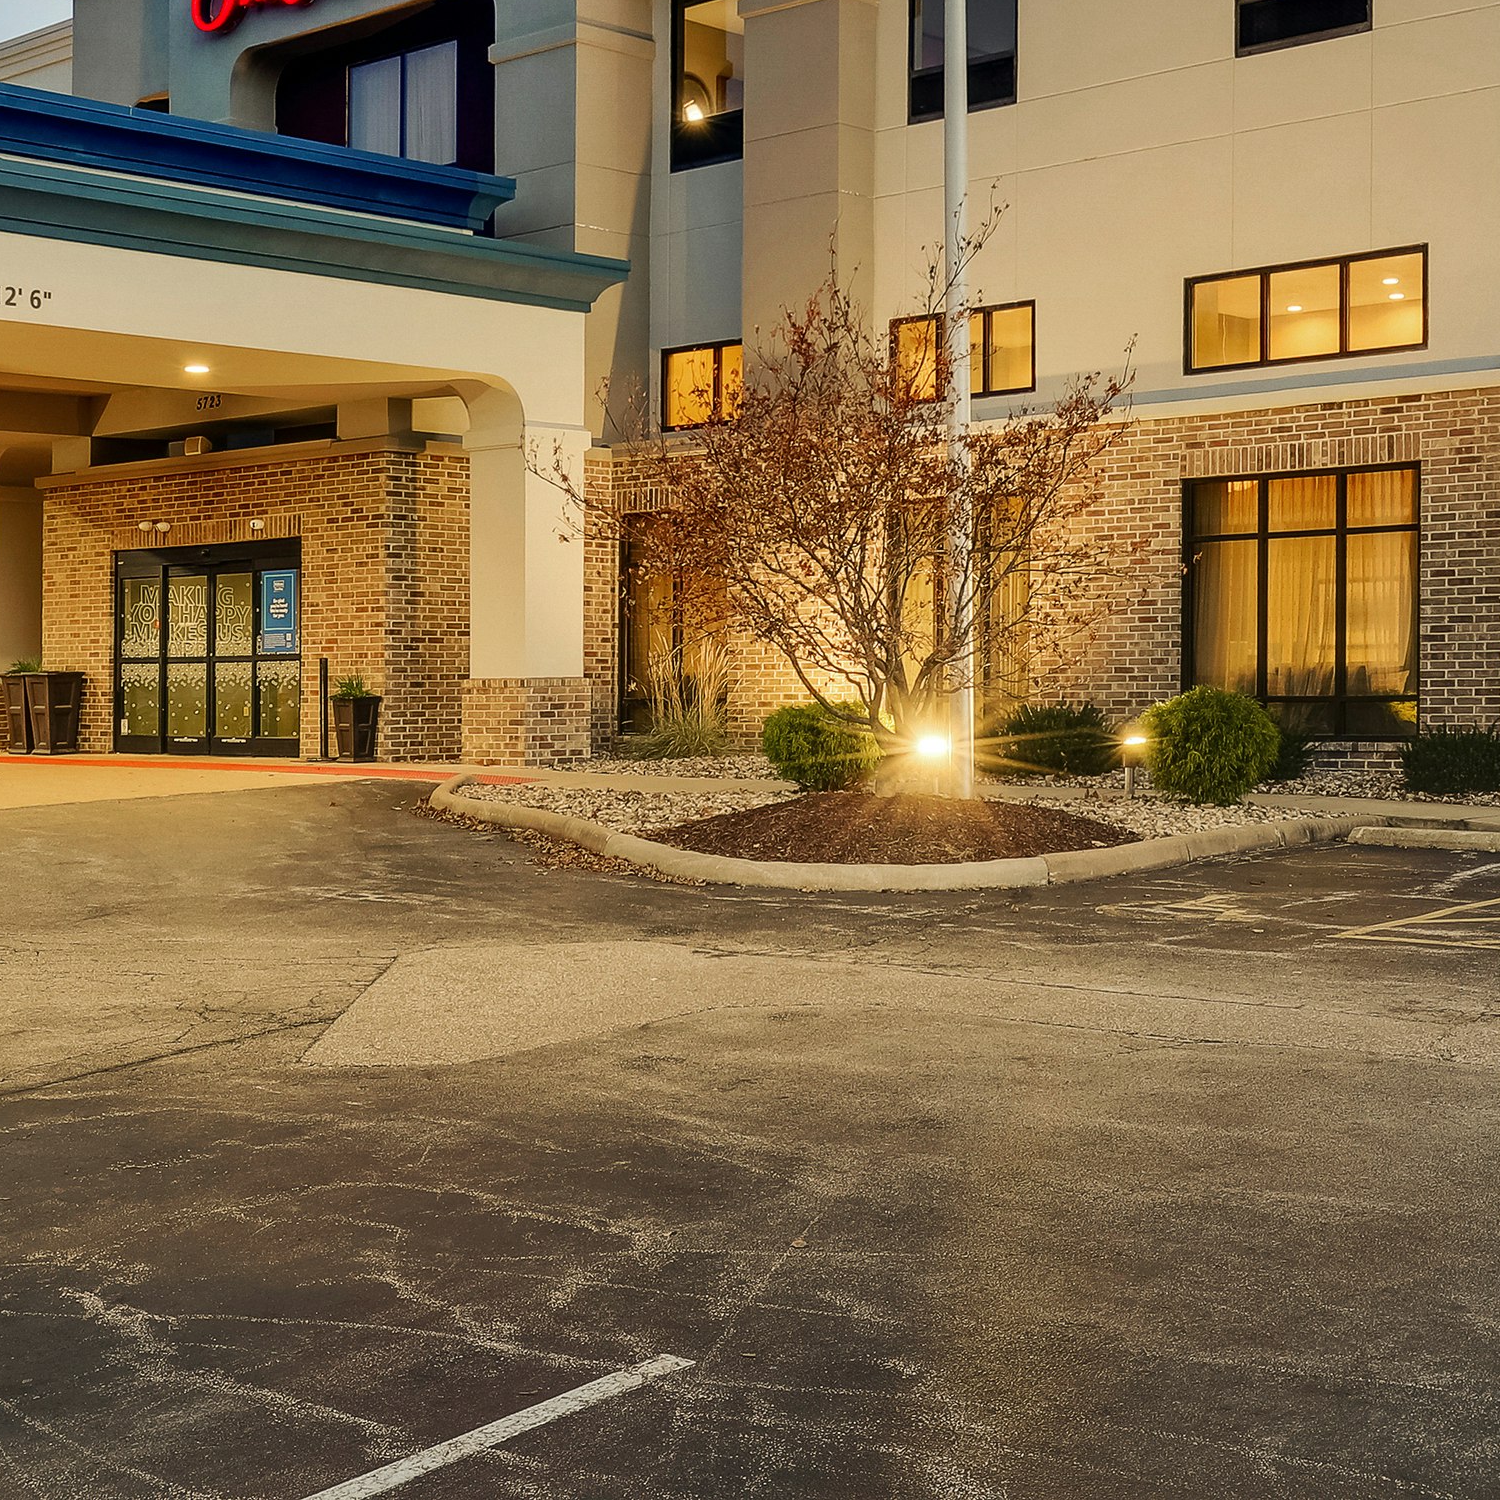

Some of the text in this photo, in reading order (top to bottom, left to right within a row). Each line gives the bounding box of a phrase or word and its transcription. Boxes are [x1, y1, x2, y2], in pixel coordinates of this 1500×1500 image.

[29, 289, 52, 310] 6"
[196, 394, 221, 411] 5723
[140, 584, 234, 607] MAKIG
